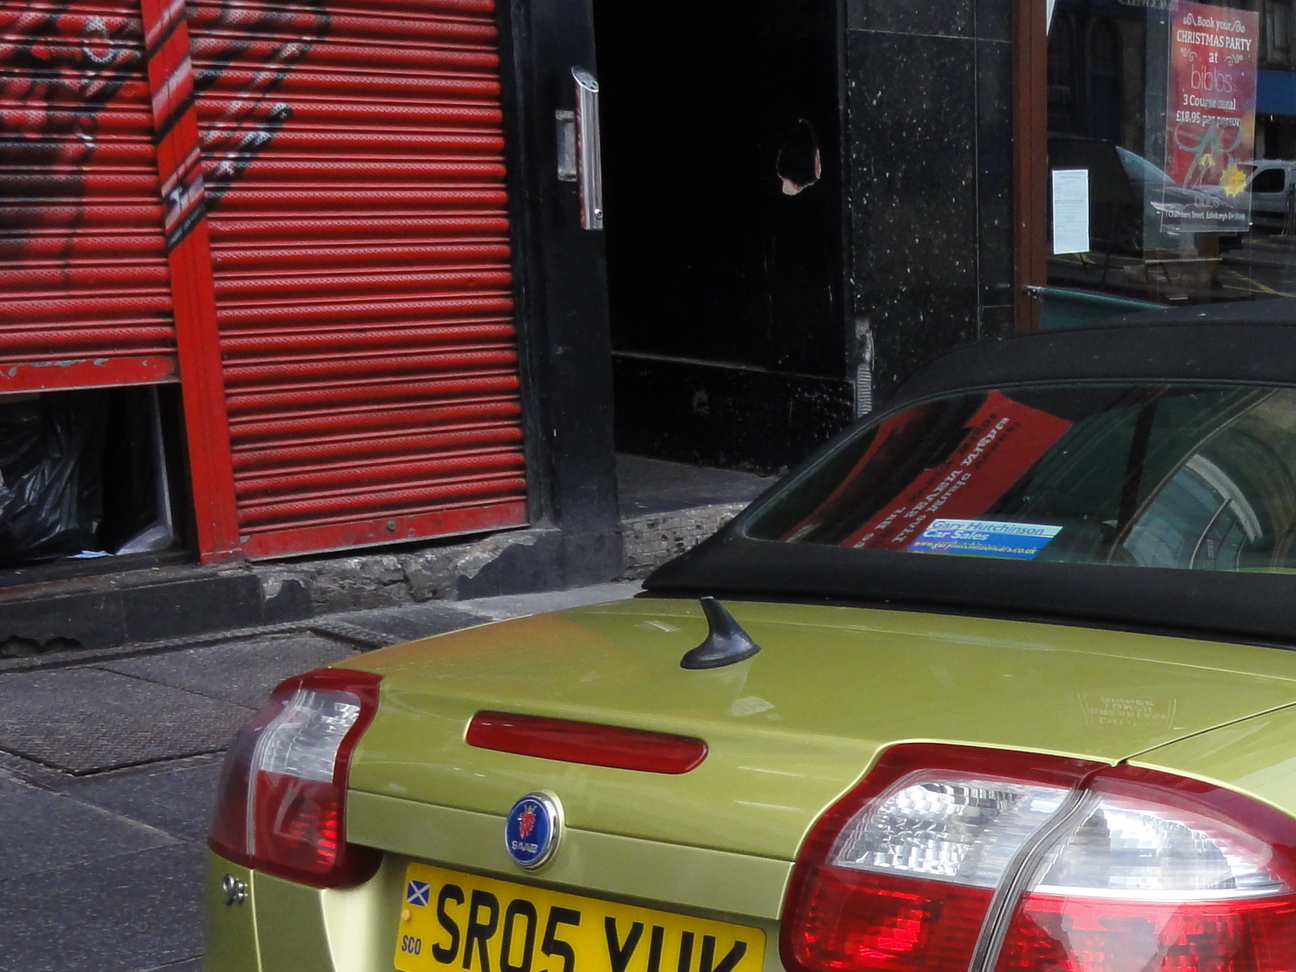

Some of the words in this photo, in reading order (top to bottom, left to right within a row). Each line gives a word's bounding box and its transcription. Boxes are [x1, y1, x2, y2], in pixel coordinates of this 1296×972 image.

[1197, 16, 1215, 28] Book
[1216, 20, 1232, 31] your
[1176, 29, 1224, 48] CHRISTMAS
[1225, 37, 1252, 51] PARTY
[1208, 52, 1218, 63] at
[1183, 94, 1189, 105] 3
[922, 529, 949, 539] Car
[951, 530, 990, 541] Sales
[932, 520, 965, 531] Gary
[966, 522, 1046, 536] Hutchinson
[511, 840, 538, 853] SAAB
[401, 934, 422, 955] SCO
